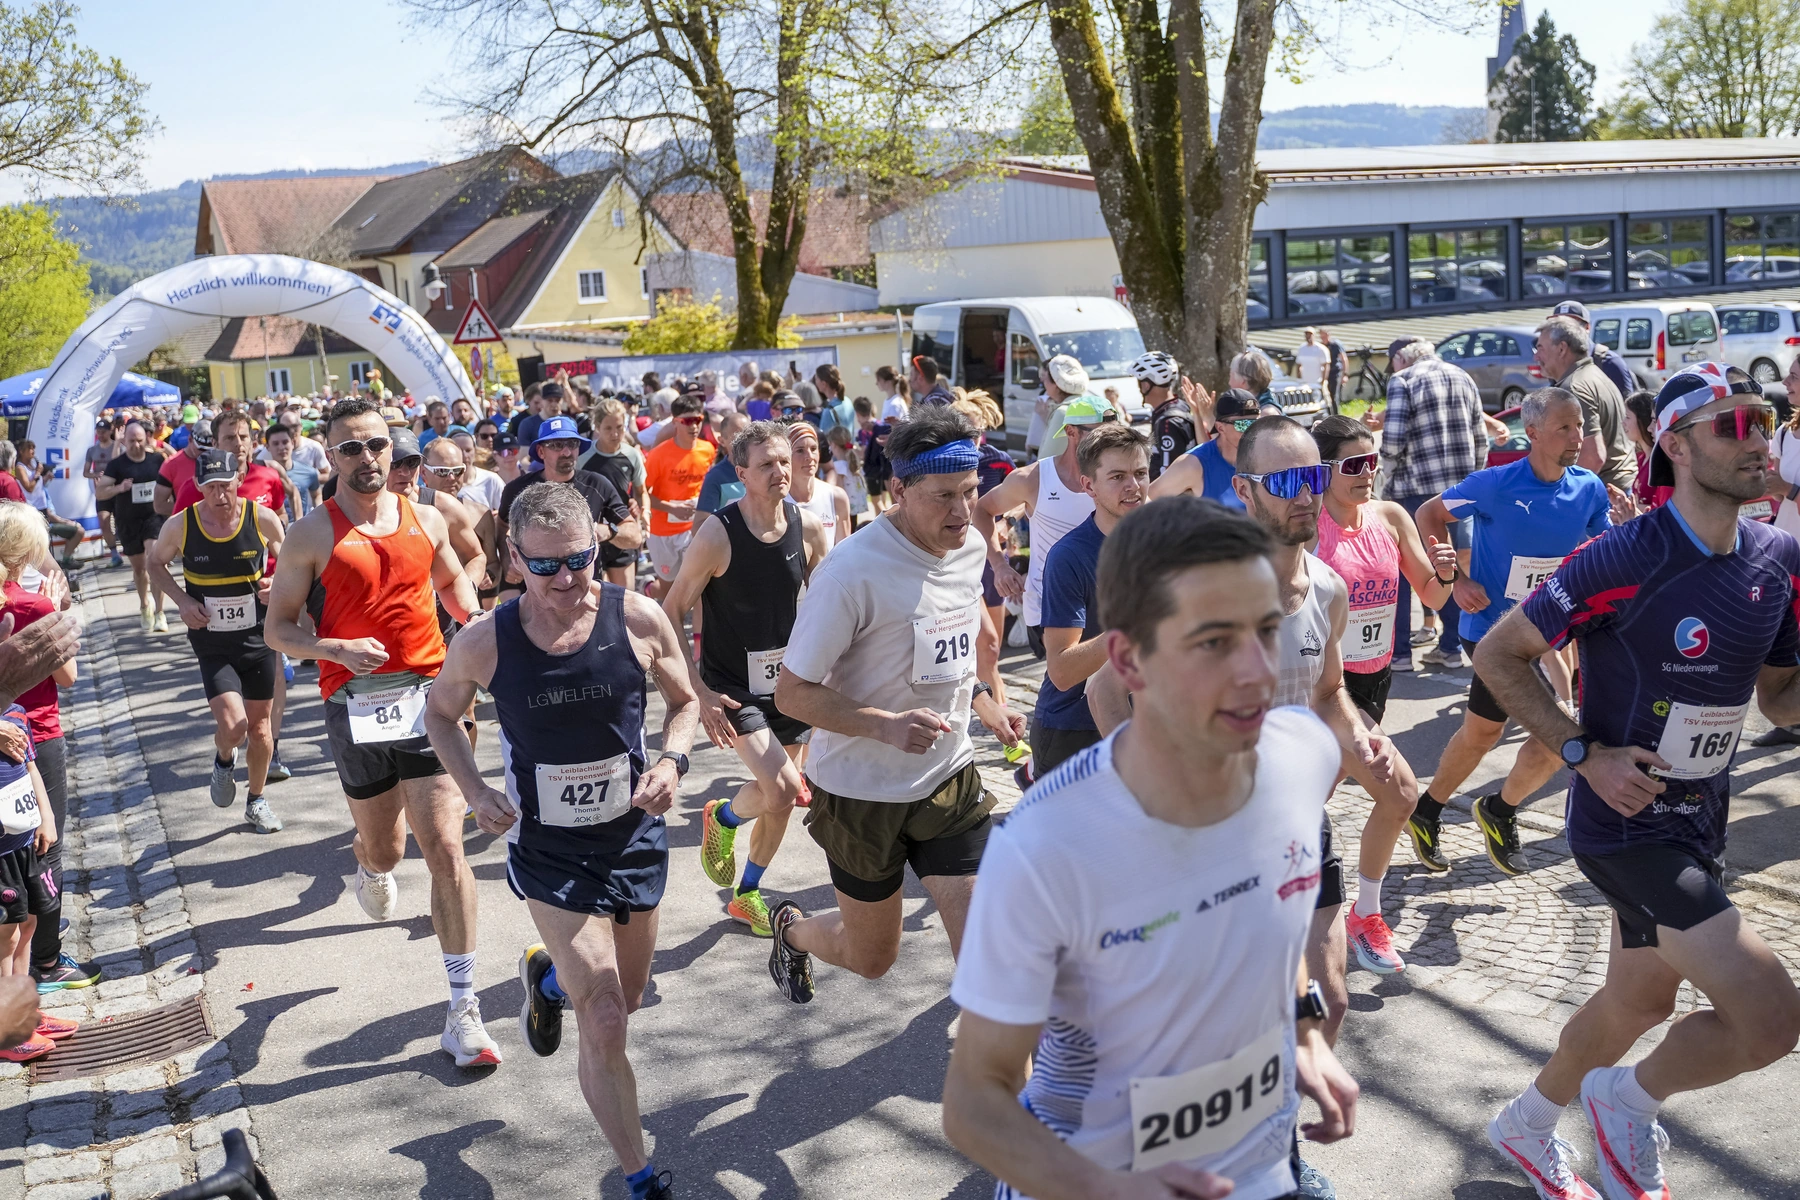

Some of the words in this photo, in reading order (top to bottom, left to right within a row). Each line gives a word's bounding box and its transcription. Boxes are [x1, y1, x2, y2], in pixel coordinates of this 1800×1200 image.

[166, 276, 227, 304] Herzlich
[230, 272, 332, 297] willkommen!
[47, 387, 70, 440] Volksbank
[217, 607, 245, 620] 134
[934, 612, 966, 626] Leiblachlauf
[1357, 609, 1386, 618] Leiblachlauf
[1360, 613, 1391, 623] Hergensweiler
[938, 618, 974, 633] Hergensweiler
[1362, 622, 1382, 643] 97
[935, 632, 970, 665] 219
[1661, 662, 1672, 672] SG
[1672, 663, 1719, 674] Niederwangen
[366, 690, 404, 700] Leiblachlauf
[371, 695, 415, 707] Hergensweiler
[527, 684, 612, 709] LGWELFEN
[375, 704, 403, 725] 84
[1700, 709, 1742, 718] Leiblachlauf
[1683, 718, 1700, 726] TSV
[1688, 731, 1733, 759] 169
[560, 763, 608, 775] Leiblachlauf
[565, 767, 620, 782] Hergensweiler
[560, 779, 610, 806] 427
[1652, 800, 1702, 815] Schreiber
[573, 815, 592, 824] AOK
[1213, 875, 1261, 906] TERREX
[1357, 933, 1382, 961] BROOKS
[1140, 1053, 1281, 1154] 20919
[1610, 1159, 1639, 1192] BROOKS
[1541, 1178, 1566, 1196] BROOKS
